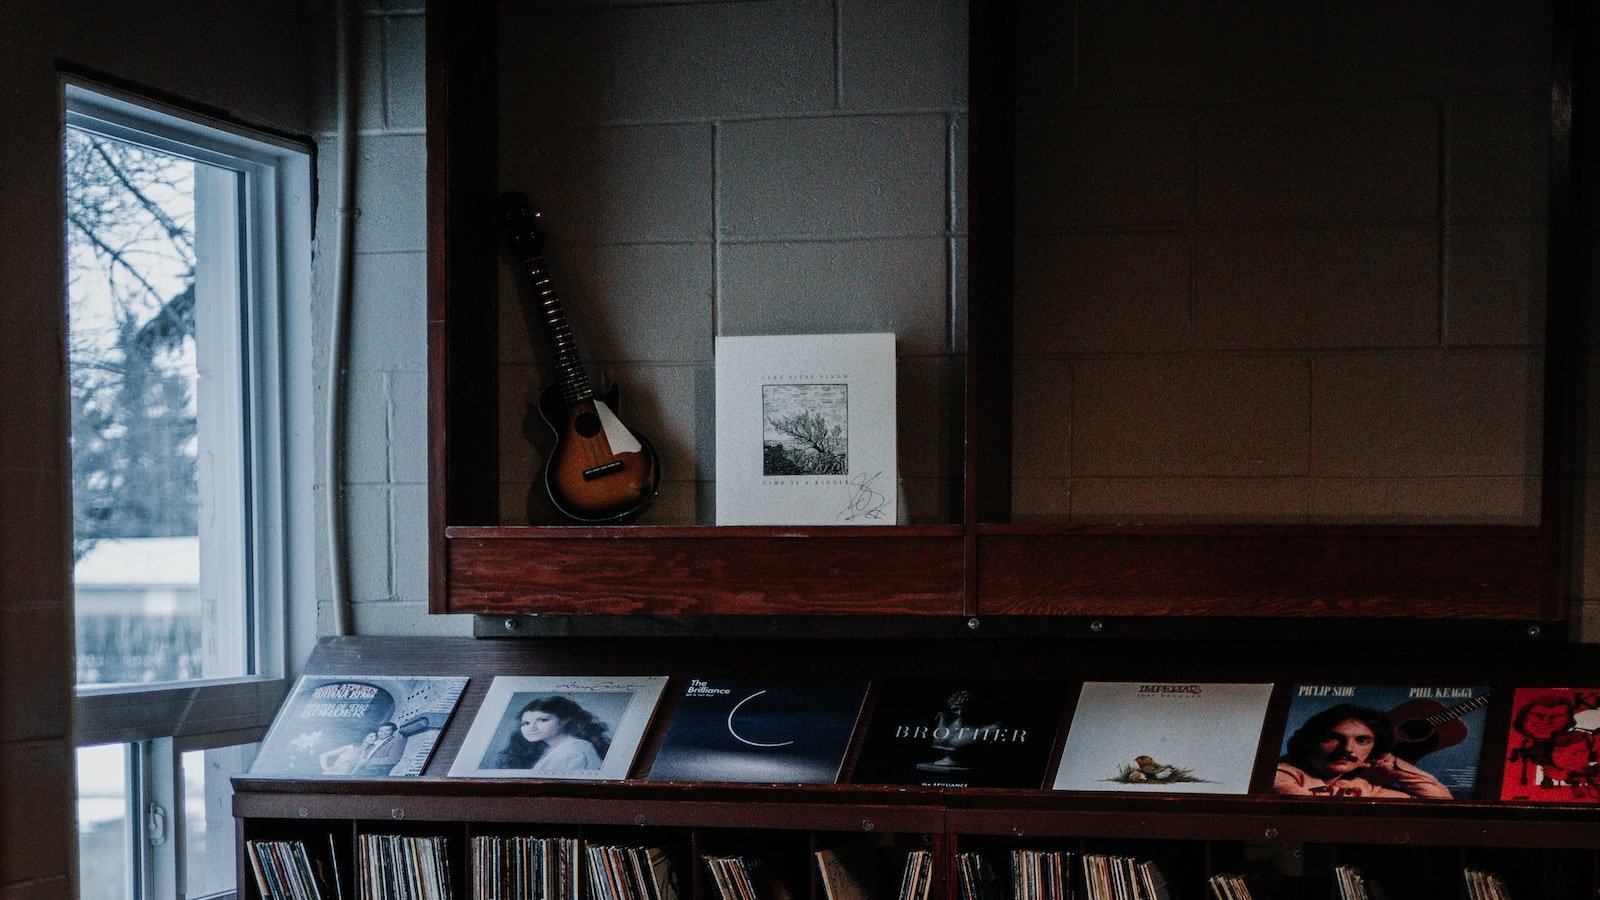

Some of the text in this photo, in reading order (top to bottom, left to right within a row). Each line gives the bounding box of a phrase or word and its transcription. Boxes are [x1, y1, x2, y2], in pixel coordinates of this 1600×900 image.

[691, 679, 708, 687] The
[687, 686, 731, 695] Brilliance
[1139, 685, 1202, 694] IMPERIALS
[1331, 686, 1356, 697] SIDE
[1409, 687, 1434, 698] PHIL
[302, 709, 367, 719] BORDER
[895, 725, 1027, 742] BROTHER
